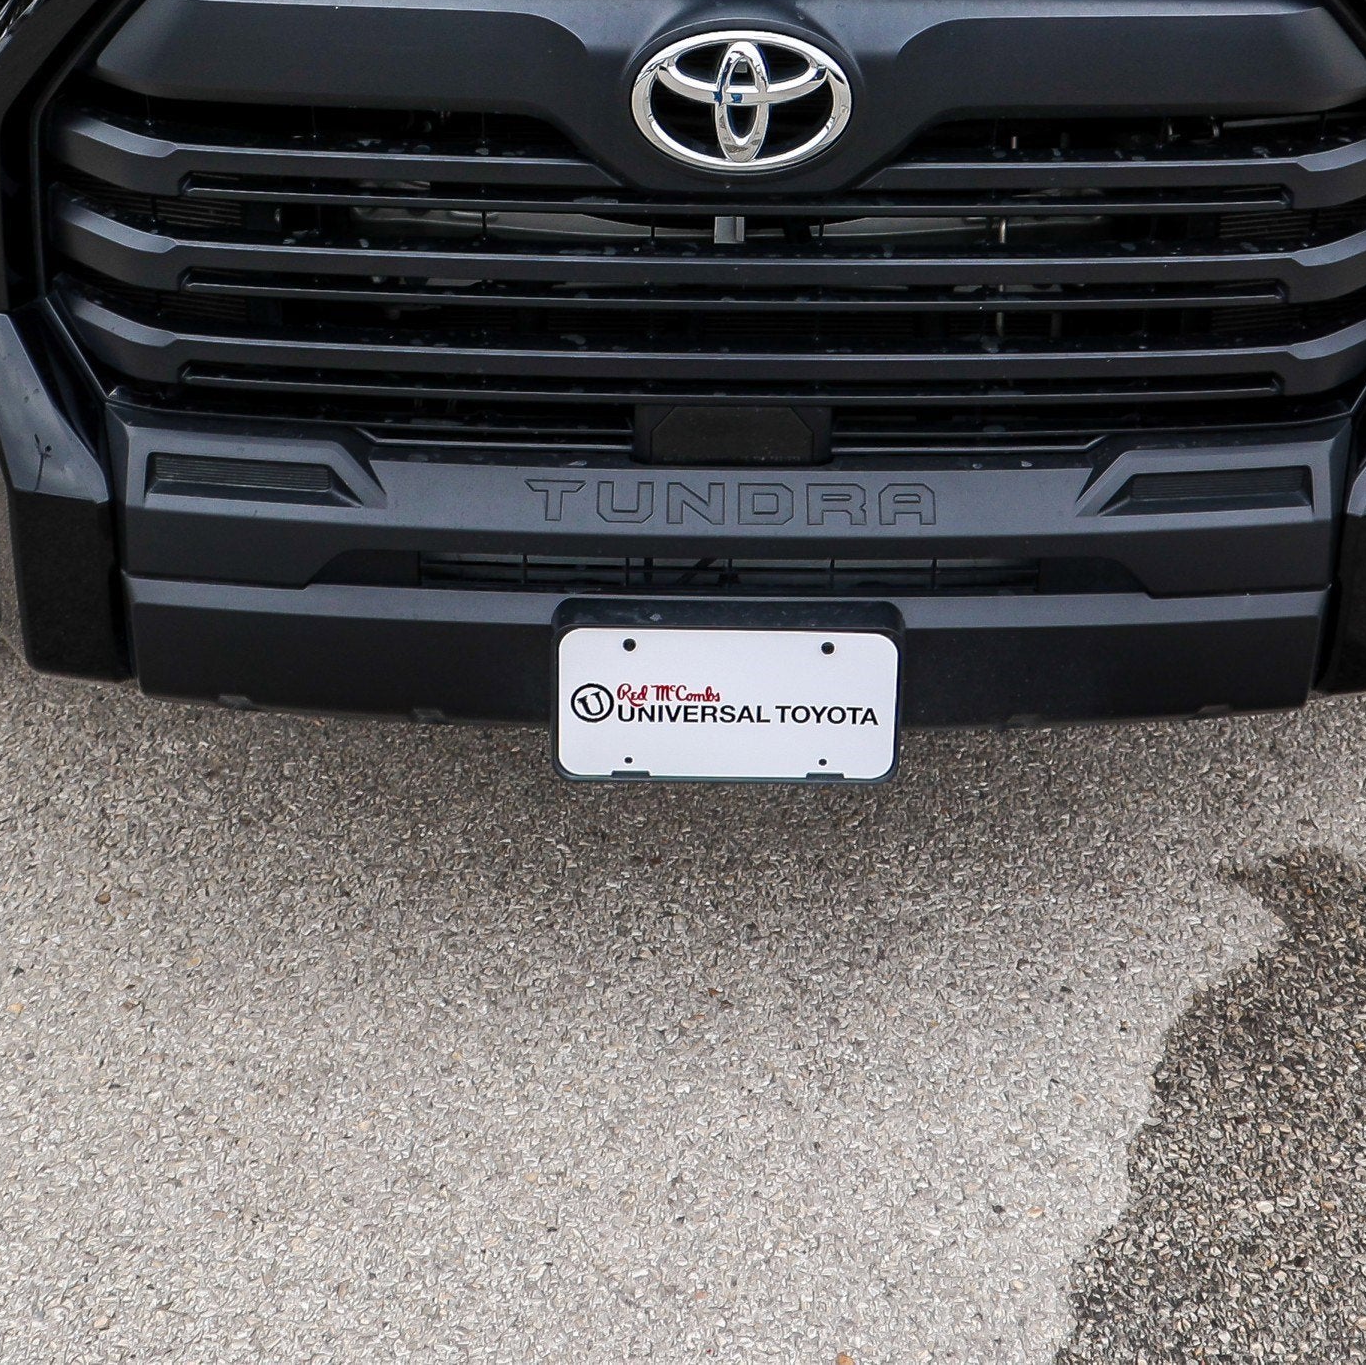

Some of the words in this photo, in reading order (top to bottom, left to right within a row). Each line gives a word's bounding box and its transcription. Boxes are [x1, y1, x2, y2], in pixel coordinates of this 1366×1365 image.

[525, 478, 936, 526] TUNDRA
[617, 683, 648, 707] Red
[651, 685, 720, 702] McCombs
[617, 704, 770, 724] UNIVERSAL
[775, 705, 879, 726] TOYOTA
